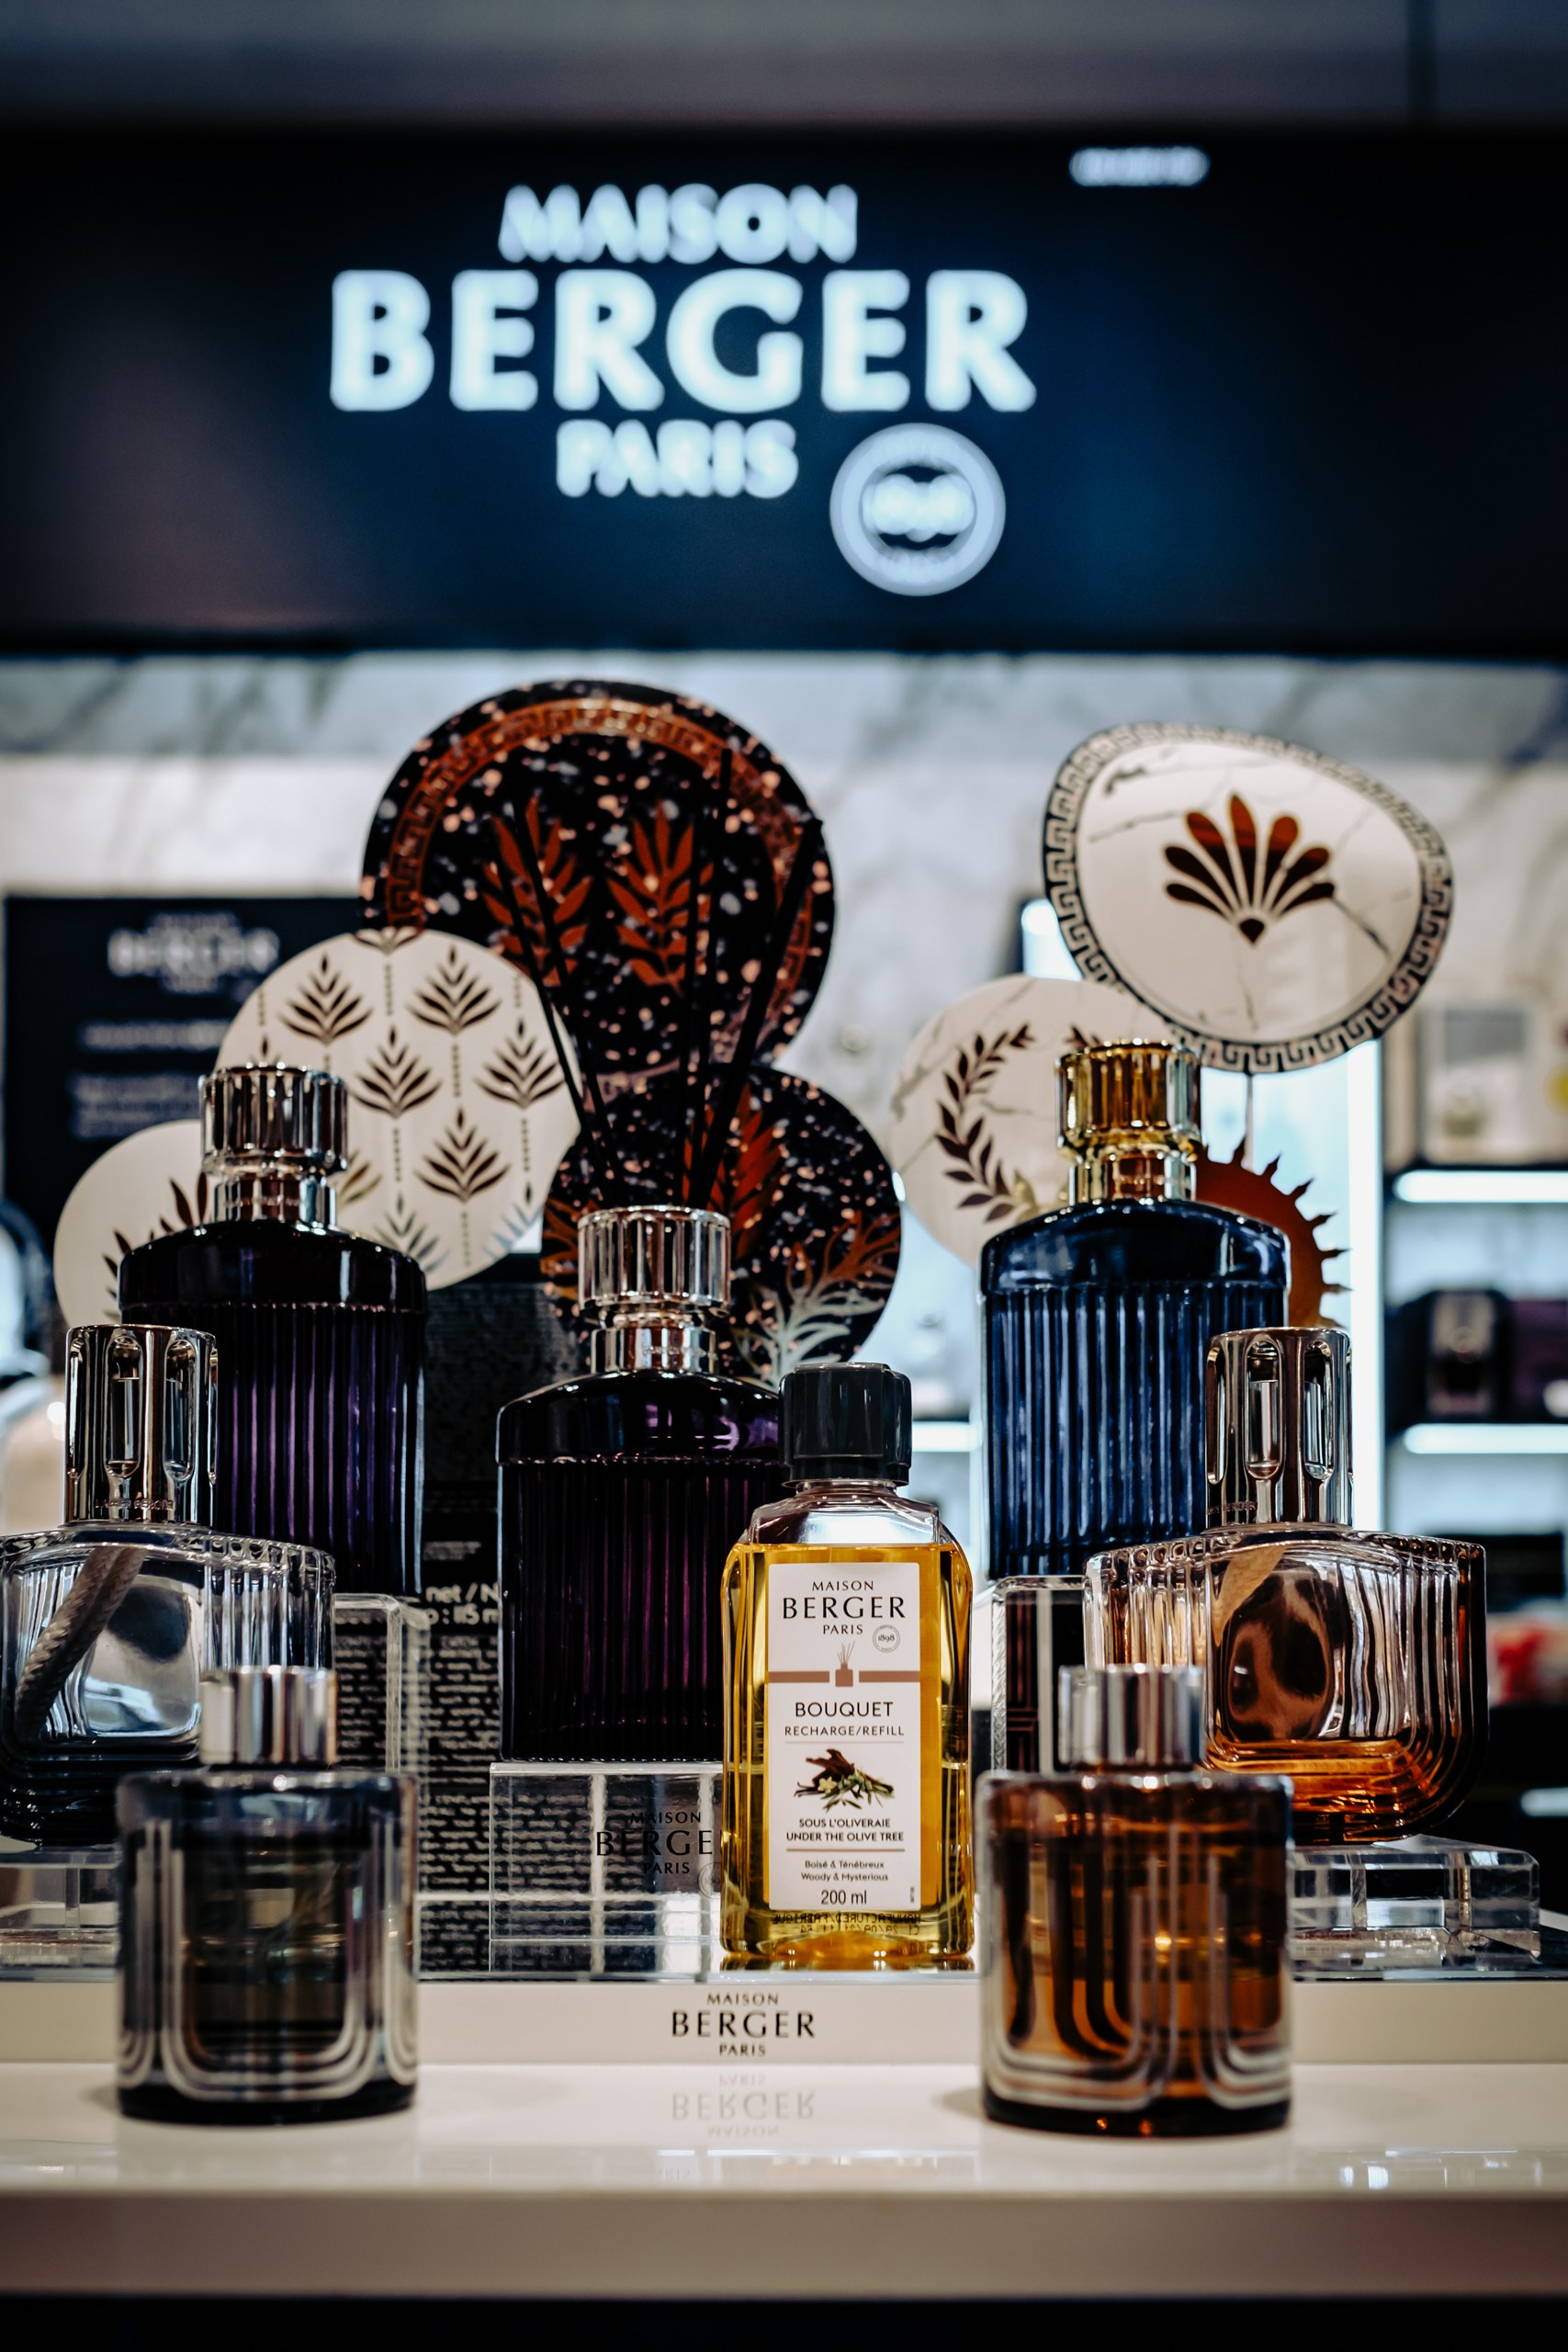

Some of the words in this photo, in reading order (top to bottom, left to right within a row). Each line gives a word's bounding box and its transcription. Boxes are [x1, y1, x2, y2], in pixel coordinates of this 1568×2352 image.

[498, 183, 858, 265] MAISON
[330, 268, 1037, 413] BERGER
[556, 419, 799, 498] PARIS
[812, 1580, 874, 1591] MAISON
[425, 1585, 461, 1603] net
[783, 1597, 906, 1619] BERGER
[823, 1624, 863, 1635] PARIS
[877, 1634, 896, 1643] 1898
[795, 1702, 894, 1717] BOUQUET
[784, 1725, 905, 1736] RECHARGE/REFILL
[629, 1812, 702, 1824] MAISON
[799, 1818, 827, 1828] SOUS
[829, 1818, 891, 1828] L'OLIVERAIE
[596, 1829, 722, 1856] BERGE
[786, 1832, 822, 1841] UNDER
[825, 1832, 844, 1841] THE
[847, 1832, 877, 1841] OLIVE
[881, 1832, 904, 1841] TREE
[644, 1861, 690, 1874] PARIS
[805, 1860, 828, 1869] Boisé
[829, 1860, 837, 1869] &
[839, 1860, 885, 1869] Ténébreux
[800, 1872, 831, 1883] Woody
[832, 1872, 840, 1881] &
[841, 1872, 889, 1883] Mysterious
[820, 1890, 847, 1905] 200
[851, 1890, 867, 1905] ml
[706, 1992, 779, 2006] MAISON
[671, 2010, 815, 2038] BERGER
[718, 2042, 766, 2056] PARIS
